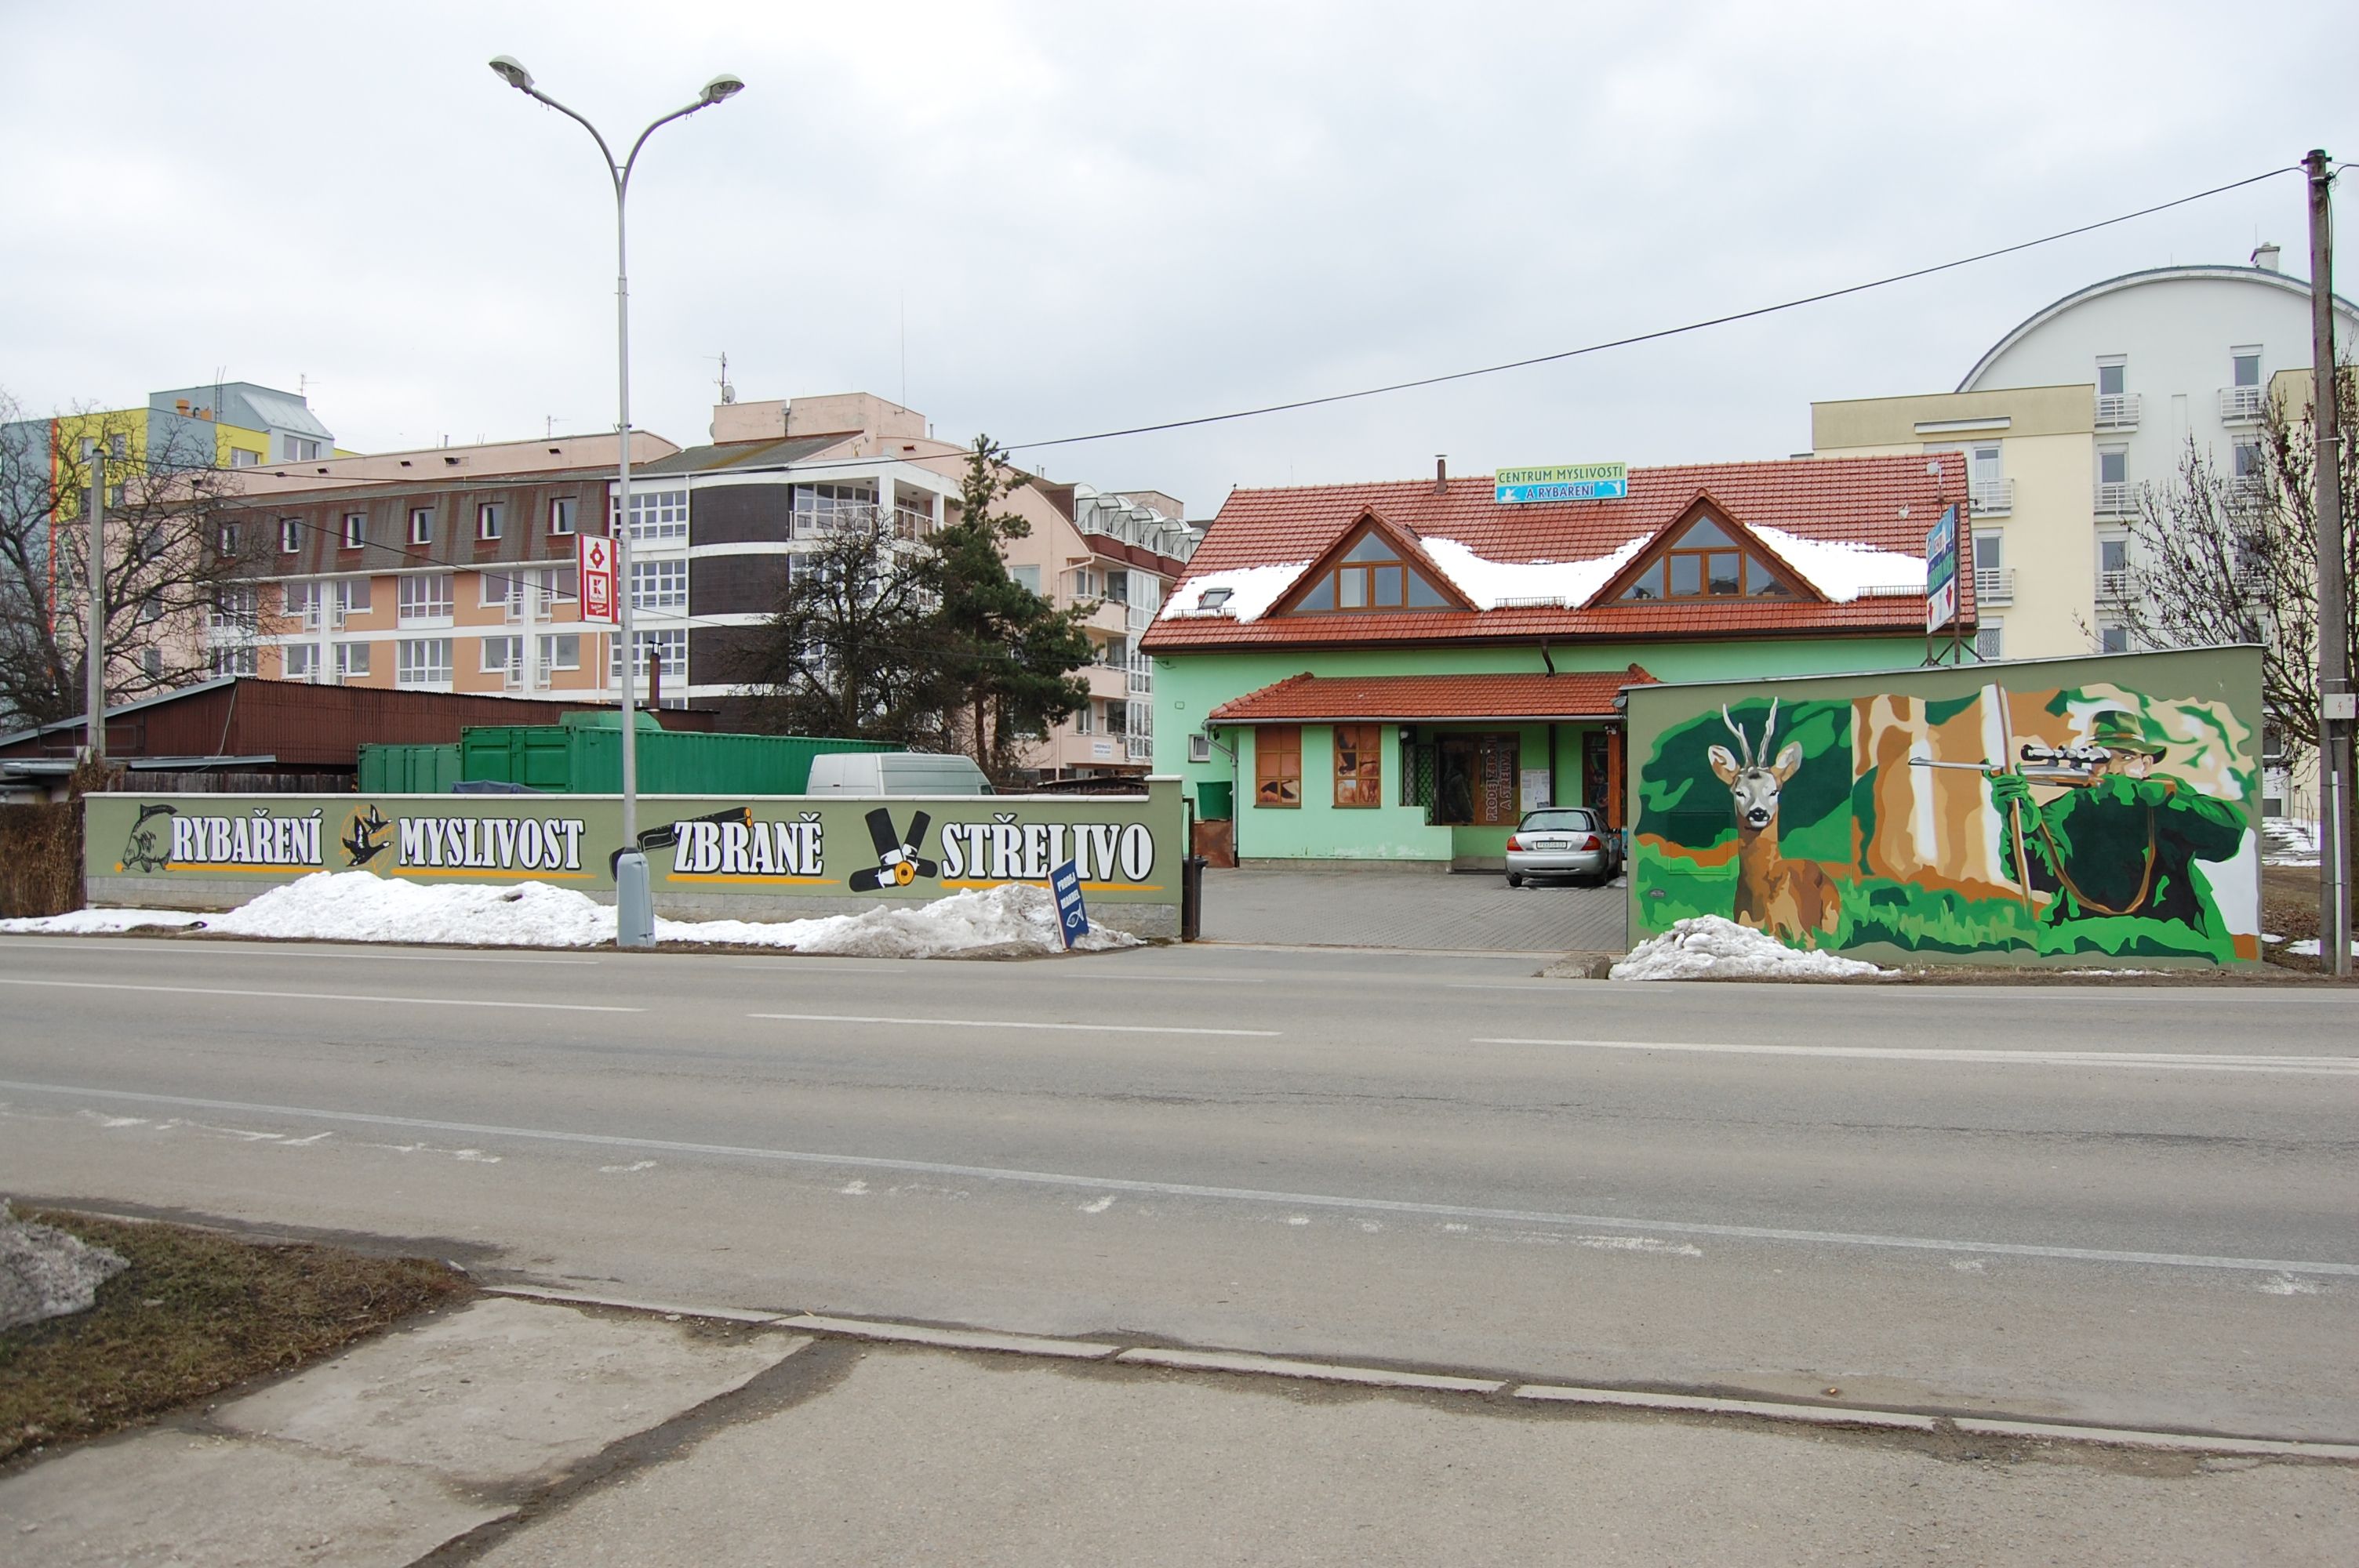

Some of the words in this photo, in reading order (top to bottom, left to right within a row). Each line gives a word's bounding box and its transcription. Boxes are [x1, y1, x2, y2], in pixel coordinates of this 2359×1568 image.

[1499, 468, 1552, 483] CENTRUM
[1557, 466, 1623, 481] MYSLIVOSTI
[1526, 488, 1534, 499] A
[1538, 482, 1594, 499] RYBAŘENÍ
[1486, 779, 1499, 821] PRODEJ
[1500, 800, 1511, 811] A
[171, 808, 324, 866] RYBAŘENÍ
[398, 817, 585, 871] MYSLIVOST
[673, 811, 824, 877] ZBRANĚ
[940, 812, 1155, 882] STŘELIVO
